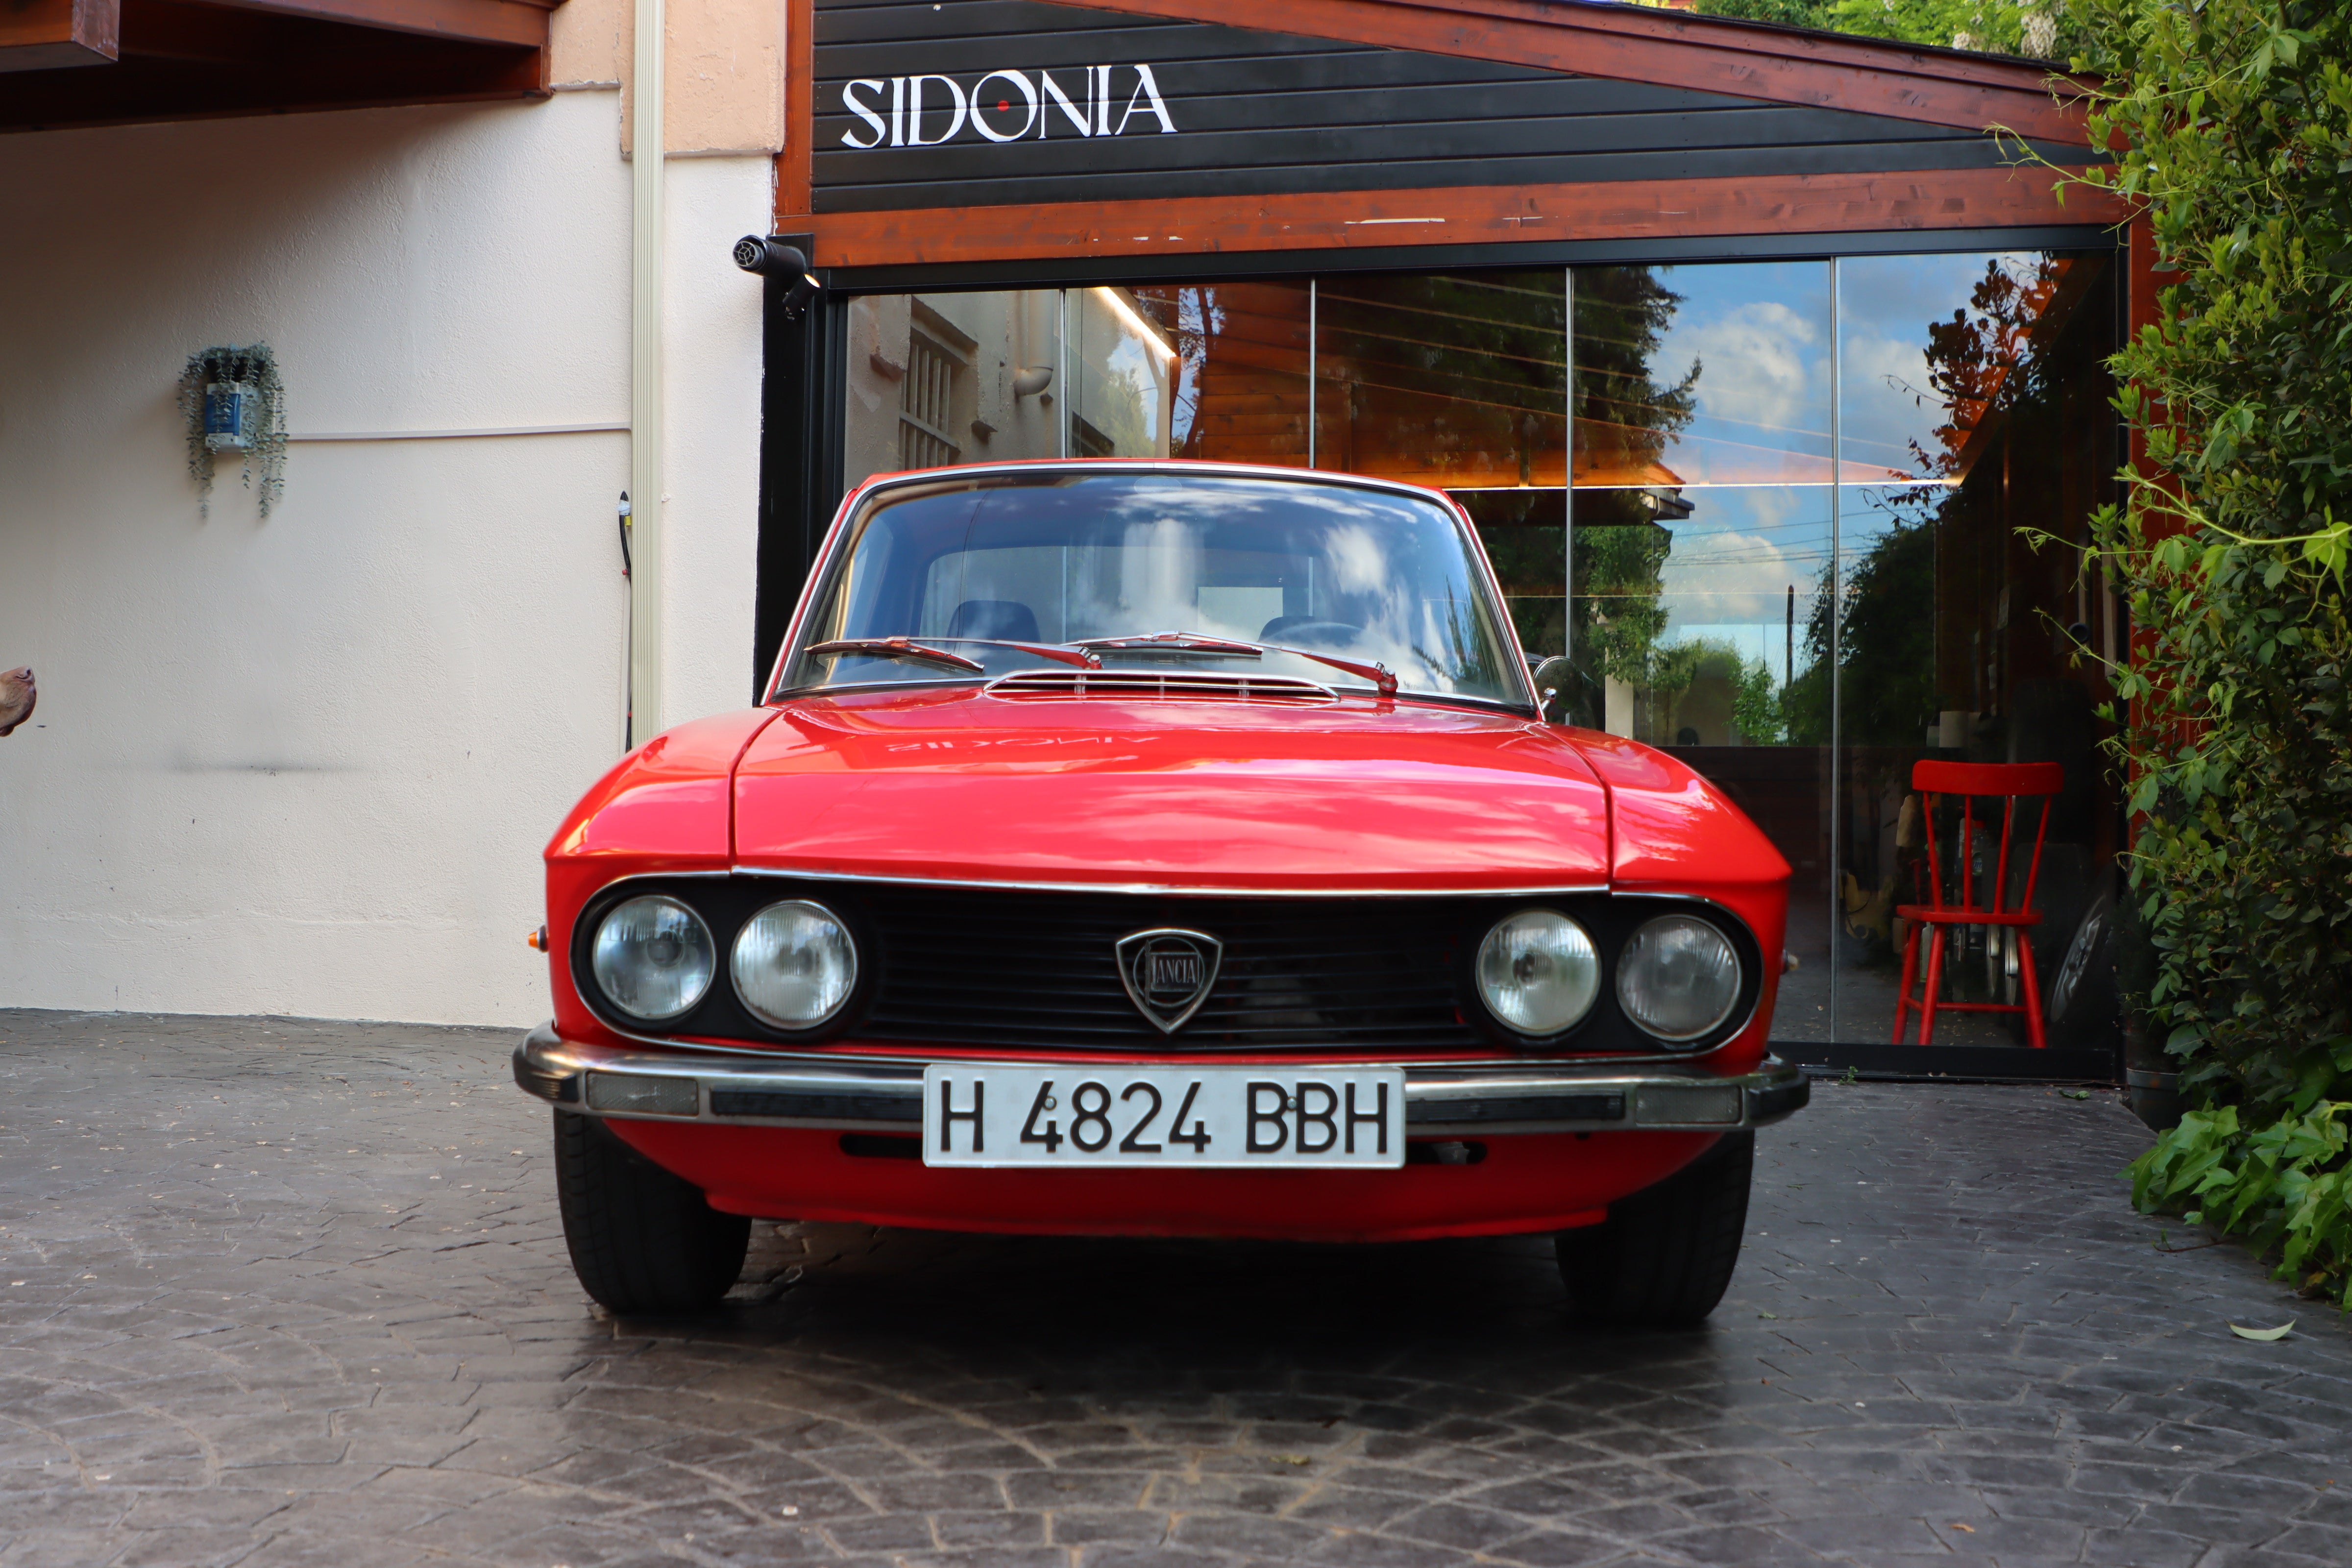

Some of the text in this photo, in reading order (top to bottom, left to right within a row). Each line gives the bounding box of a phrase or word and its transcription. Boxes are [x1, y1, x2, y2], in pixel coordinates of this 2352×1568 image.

[840, 64, 1178, 148] SIDONIA
[1151, 956, 1197, 984] LANCIA
[940, 1080, 1389, 1154] H 4824 BBH
